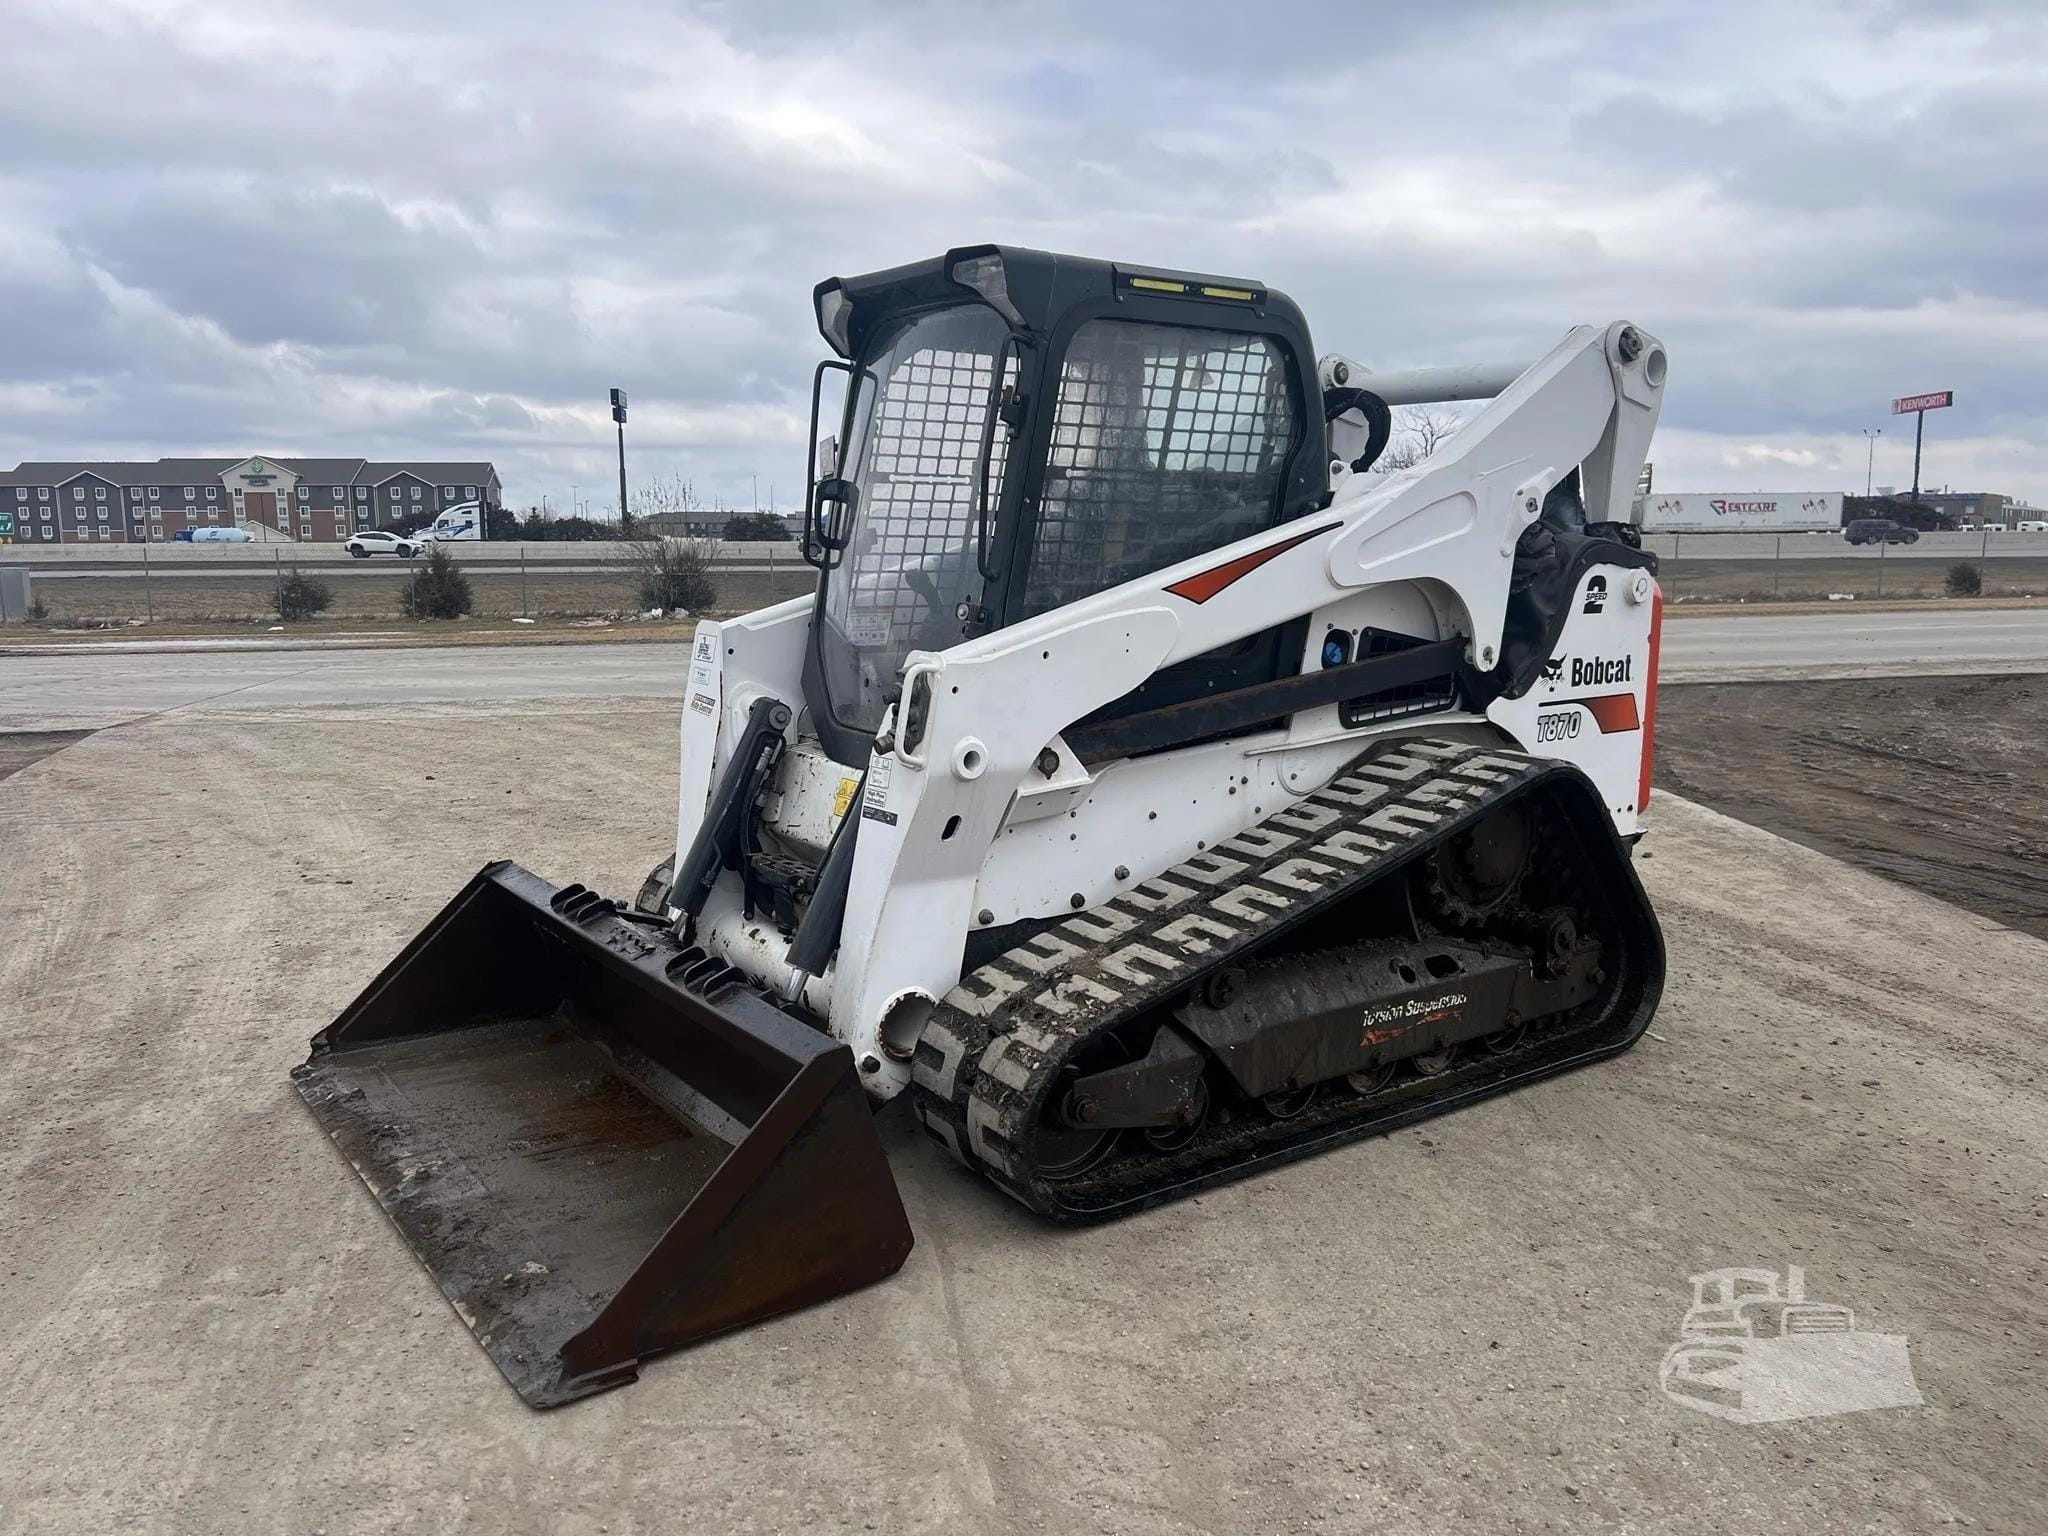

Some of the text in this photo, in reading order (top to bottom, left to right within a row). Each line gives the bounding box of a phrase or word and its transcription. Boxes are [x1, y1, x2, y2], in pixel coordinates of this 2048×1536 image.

[1902, 394, 1947, 411] KENWORTH
[1583, 575, 1607, 614] 2
[1585, 592, 1608, 601] SPEED
[1571, 654, 1632, 687] Bobcat
[1537, 711, 1582, 743] T870
